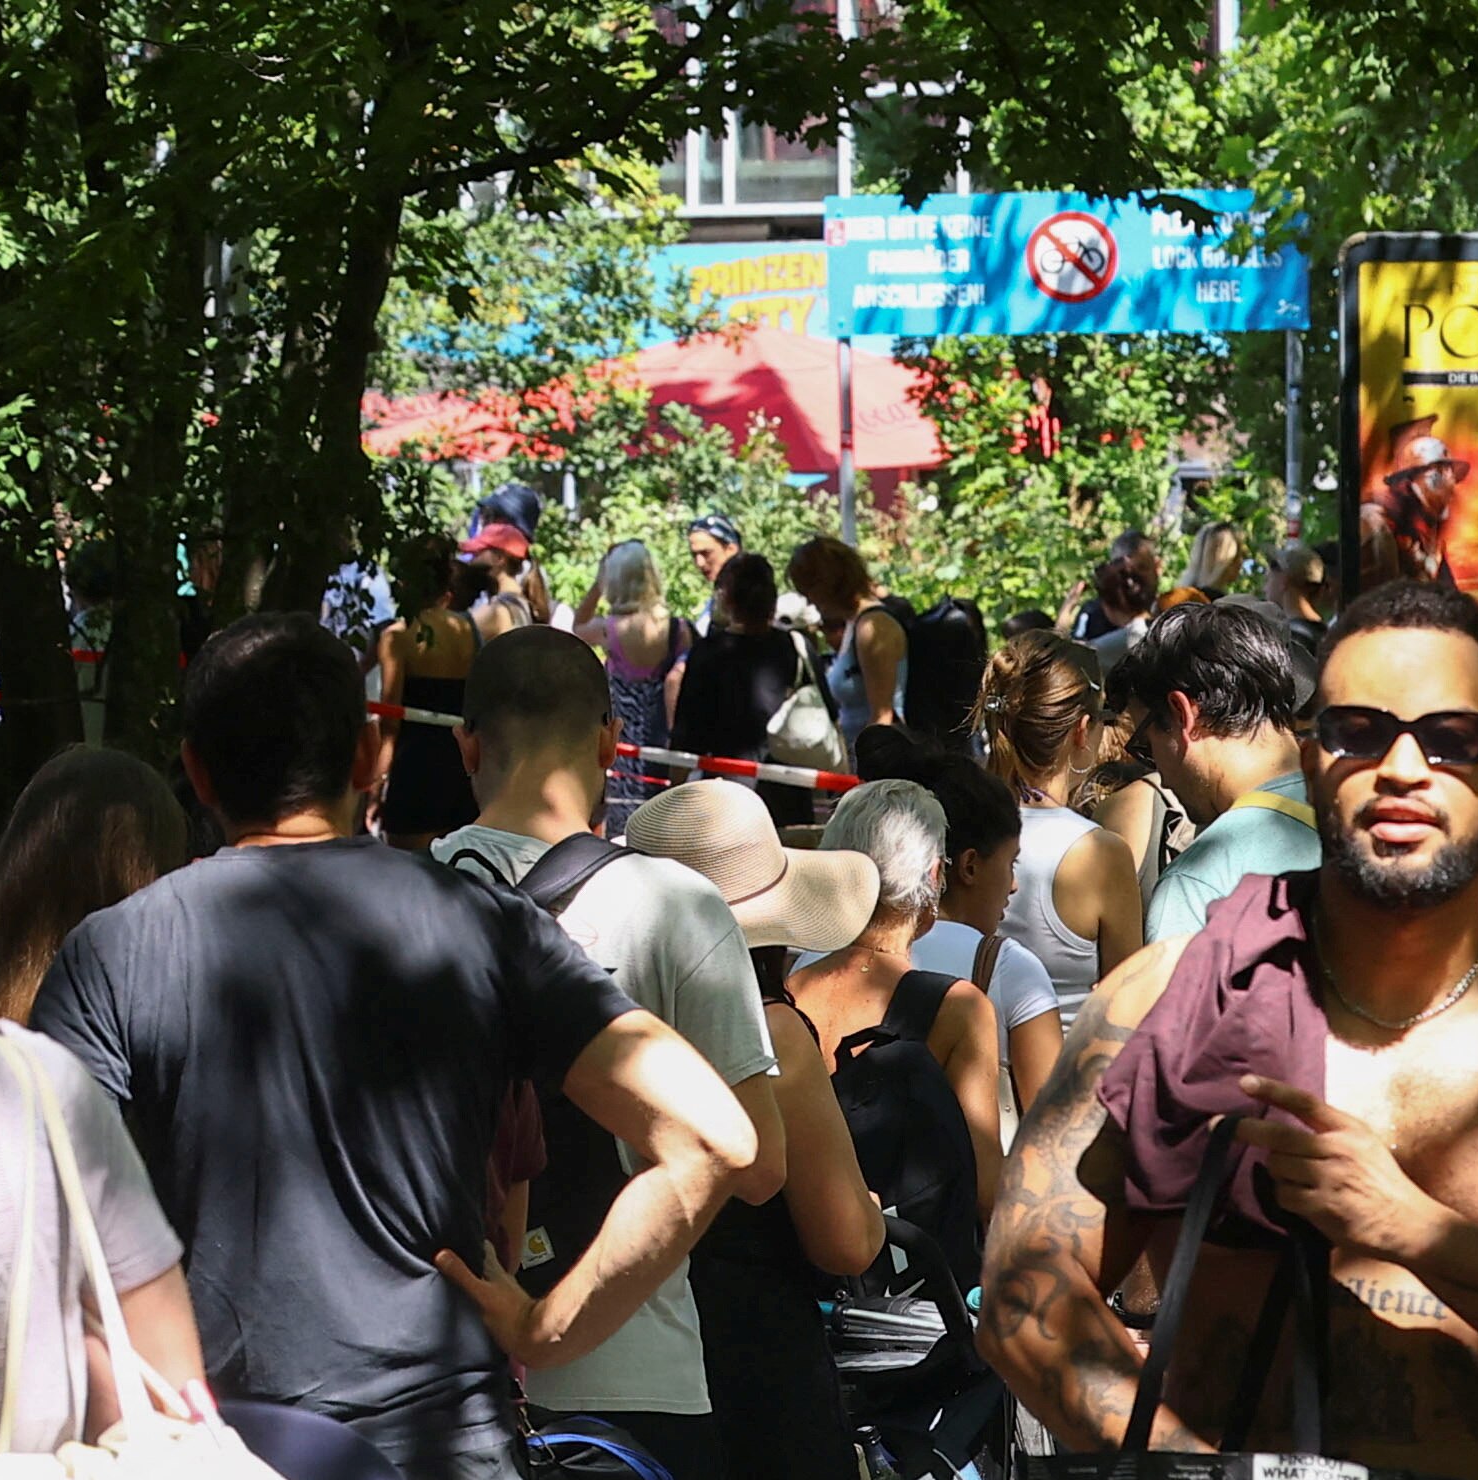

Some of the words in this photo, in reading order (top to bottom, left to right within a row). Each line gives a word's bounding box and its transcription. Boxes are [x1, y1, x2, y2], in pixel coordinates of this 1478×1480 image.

[1151, 245, 1198, 270] LOCK
[689, 252, 827, 305] PRINZEN
[1195, 280, 1243, 304] HERE
[1448, 373, 1468, 385] DIE
[1262, 1467, 1307, 1480] WHAT
